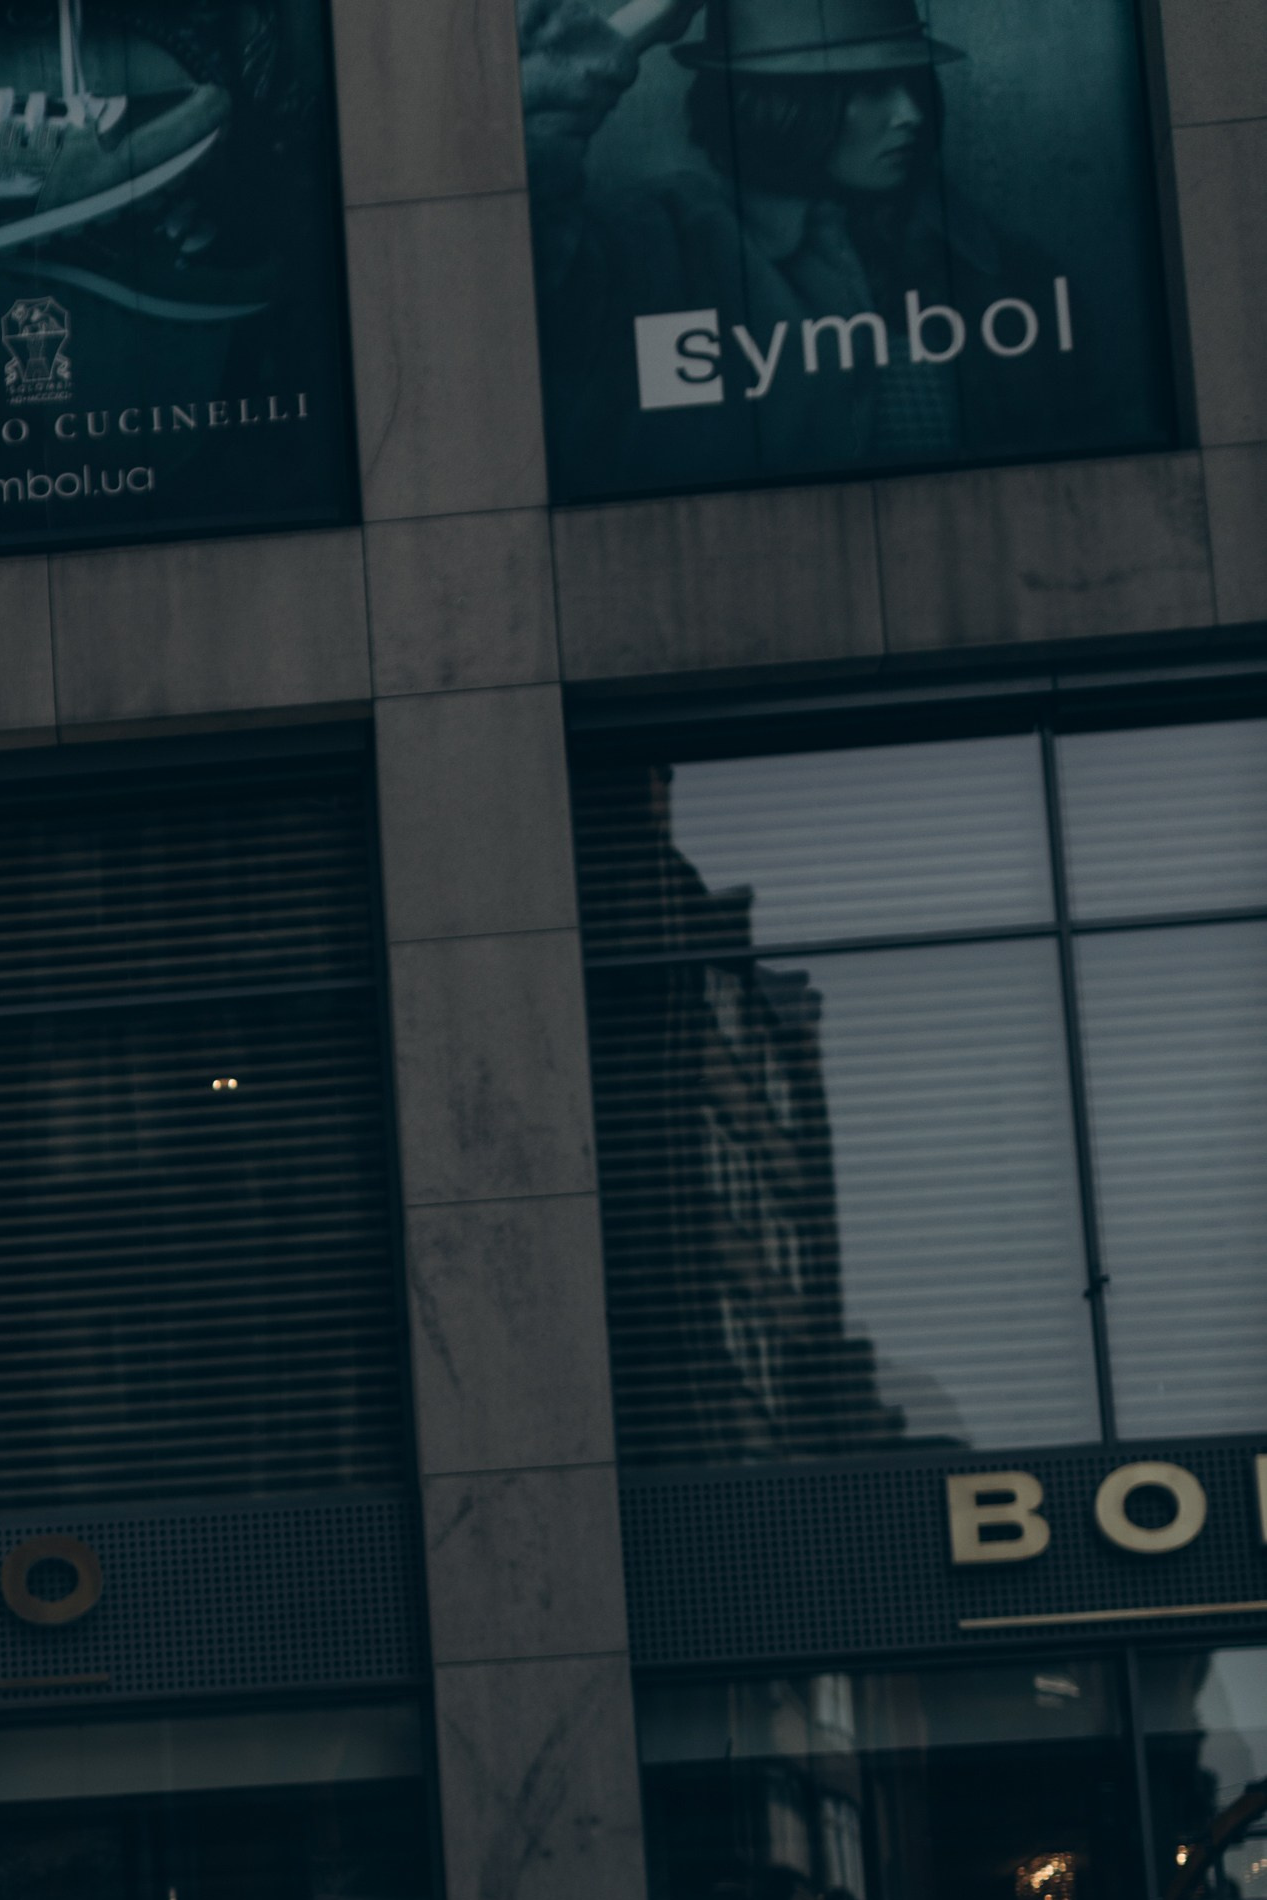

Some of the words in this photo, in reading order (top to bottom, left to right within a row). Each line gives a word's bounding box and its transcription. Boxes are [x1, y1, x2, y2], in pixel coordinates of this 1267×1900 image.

[675, 275, 1073, 399] symbol
[54, 391, 310, 439] CUCINELLI
[945, 1451, 1267, 1566] BO
